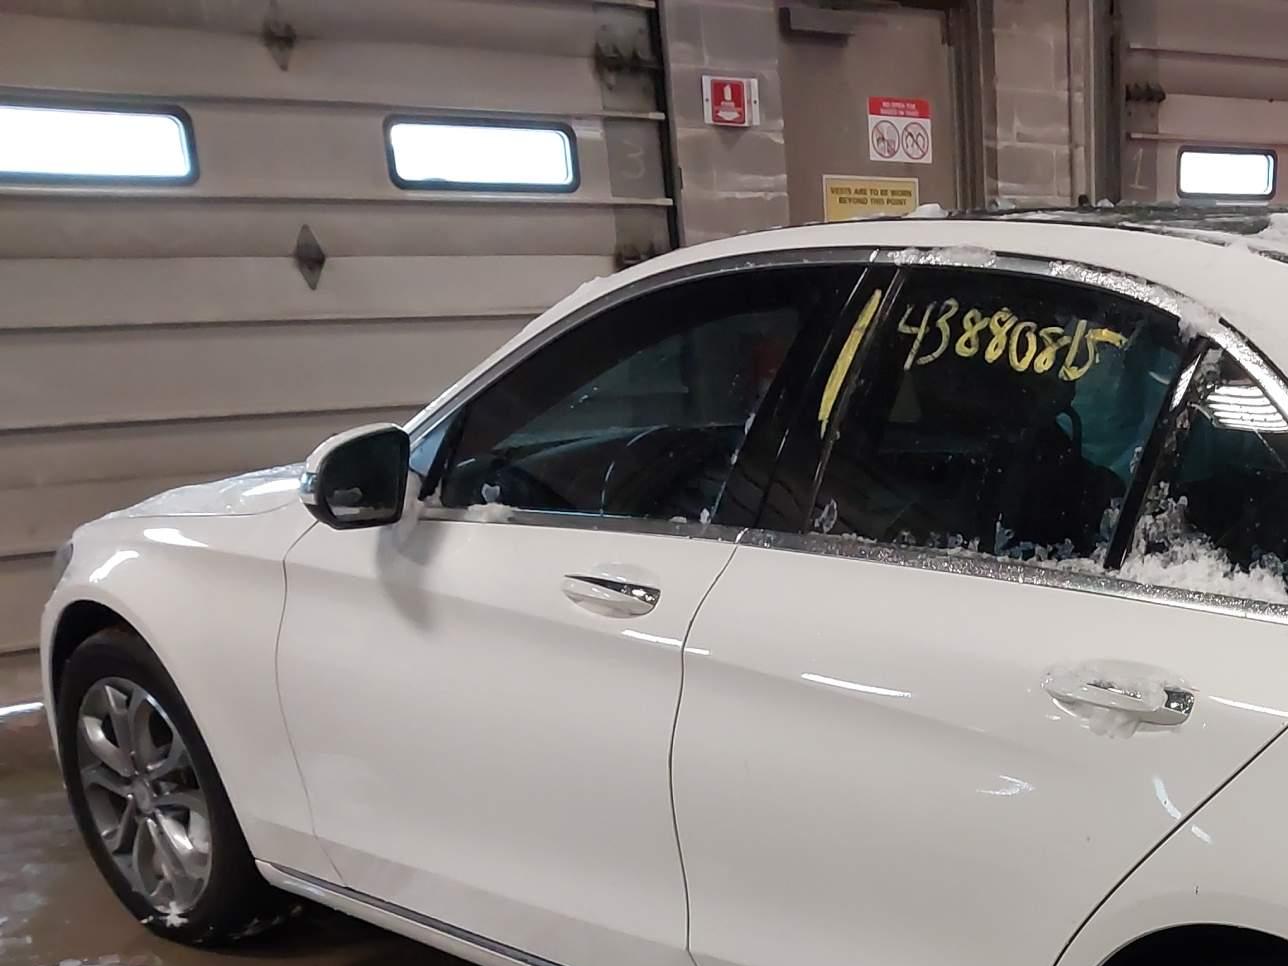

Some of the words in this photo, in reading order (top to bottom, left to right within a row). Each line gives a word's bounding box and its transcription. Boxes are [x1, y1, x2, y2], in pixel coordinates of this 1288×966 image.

[853, 188, 868, 196] ARE
[869, 188, 879, 196] TO
[838, 196, 868, 205] BEYOND
[886, 198, 907, 206] POINT
[898, 298, 1128, 381] 43880815
